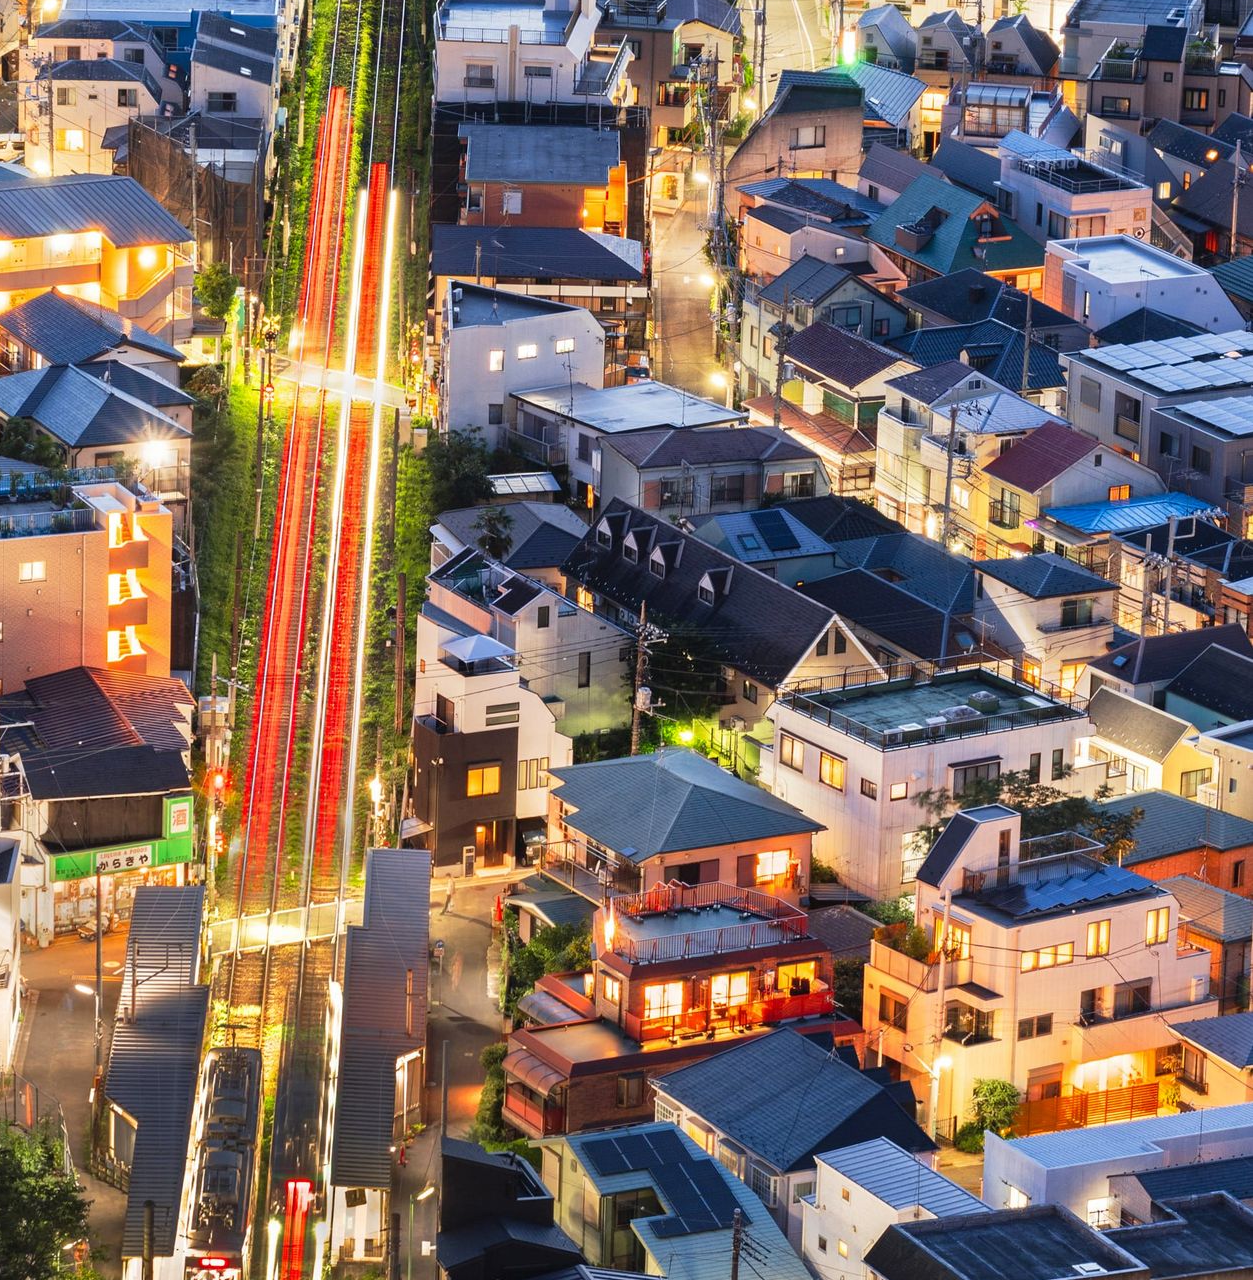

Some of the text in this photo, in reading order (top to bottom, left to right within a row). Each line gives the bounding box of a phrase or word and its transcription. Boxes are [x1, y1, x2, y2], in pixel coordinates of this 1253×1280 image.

[173, 809, 187, 827] 酒
[99, 854, 149, 871] からきや
